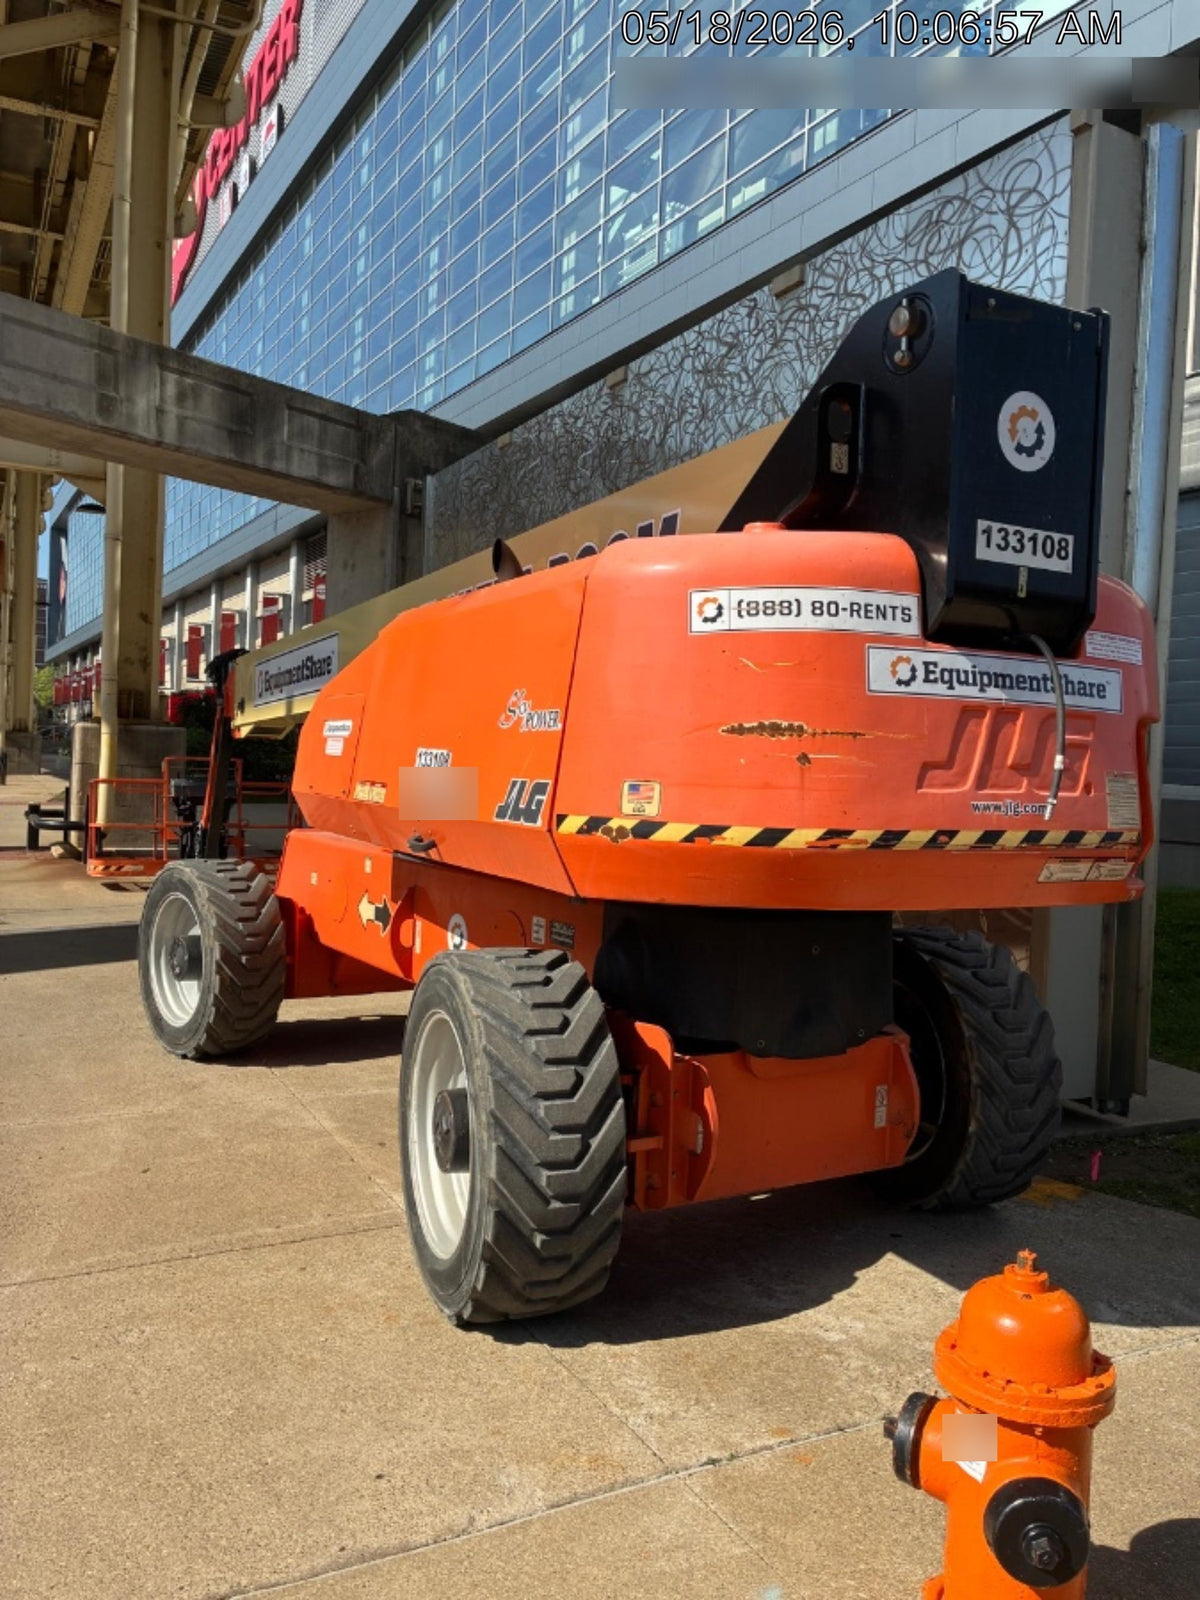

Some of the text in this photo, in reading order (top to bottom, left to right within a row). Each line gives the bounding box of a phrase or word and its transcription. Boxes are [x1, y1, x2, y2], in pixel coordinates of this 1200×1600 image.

[981, 524, 1070, 561] 133108
[737, 599, 912, 623] (888) 80-RENTS
[494, 778, 551, 826] JLG
[971, 801, 1048, 817] www.jlg.com
